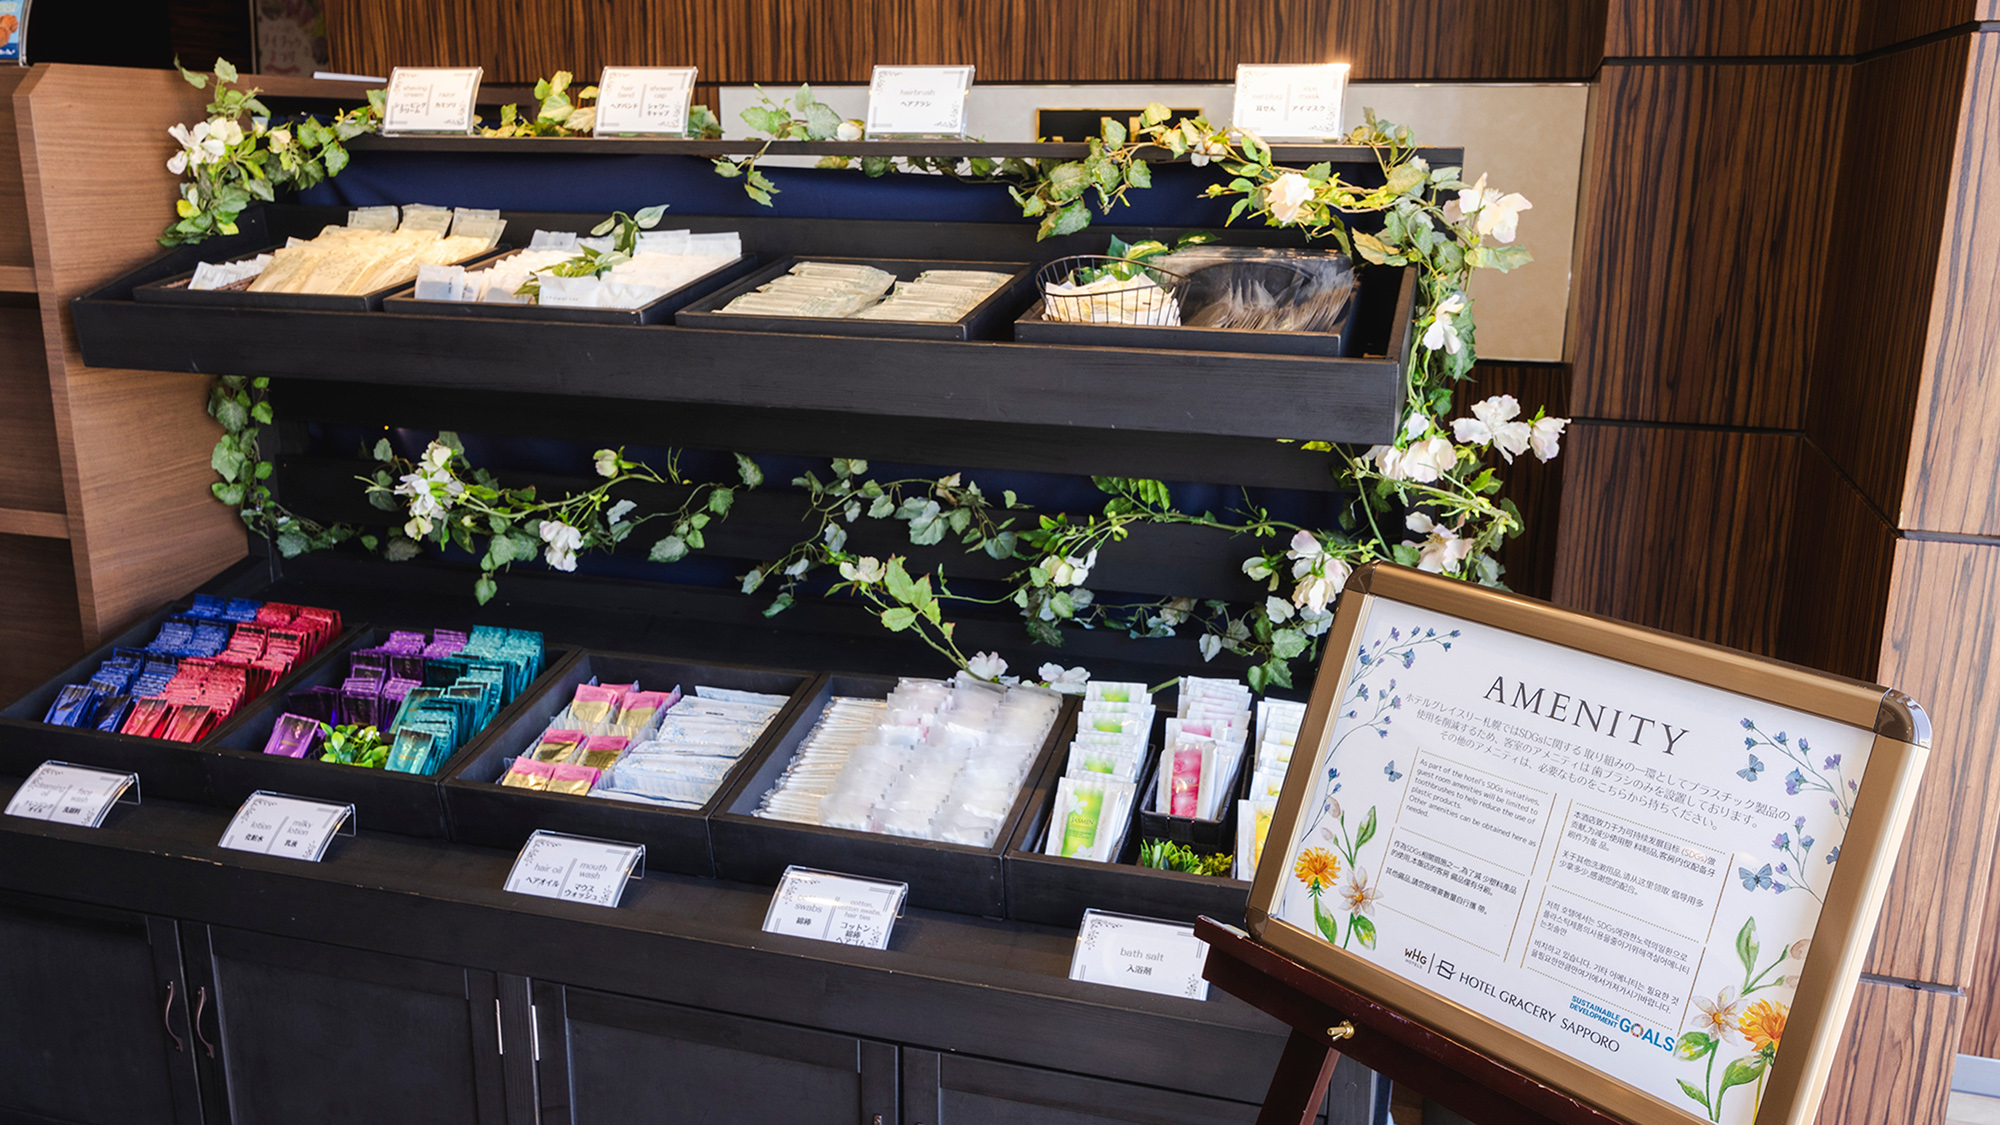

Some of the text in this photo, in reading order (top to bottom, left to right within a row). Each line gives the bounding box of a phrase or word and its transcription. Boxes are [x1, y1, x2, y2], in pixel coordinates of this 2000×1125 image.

[1483, 676, 1689, 756] AMENITY
[1419, 758, 1428, 767] As
[1428, 762, 1442, 772] part
[1451, 770, 1463, 779] the
[1463, 773, 1485, 787] hotel's
[1486, 781, 1503, 793] SDGs
[1504, 789, 1540, 806] initiatives,
[1410, 786, 1461, 809] plastic products.
[1416, 768, 1538, 816] guest room amenities will be limited to
[1414, 777, 1455, 796] toothbrushes
[1456, 792, 1464, 800] to
[1464, 794, 1479, 805] help
[1478, 800, 1501, 813] reduce
[1502, 808, 1514, 817] the
[1514, 813, 1527, 822] use
[1405, 804, 1428, 818] needed.
[292, 820, 312, 828] milky
[1408, 794, 1427, 806] Other
[1428, 803, 1458, 818] amenities
[1459, 814, 1471, 823] can
[1471, 818, 1481, 826] be
[1481, 822, 1511, 838] obtained
[1511, 832, 1527, 844] here
[250, 821, 272, 830] lotion
[287, 826, 308, 836] lotion
[534, 863, 564, 874] hair oil
[580, 862, 608, 872] mouth
[579, 871, 601, 880] wash
[526, 876, 560, 888] ヘアオイル
[574, 884, 596, 892] マウス
[564, 890, 598, 901] ウォッシュ
[795, 903, 822, 913] swabs
[850, 900, 874, 908] cotton,
[840, 922, 871, 932] コットン
[1120, 947, 1164, 962] bath salt
[1126, 964, 1153, 976] 入浴剤
[1459, 972, 1620, 1052] HOTEL GRACERY SAPPORO
[1571, 995, 1620, 1022] SUSTAINABLE
[1569, 1002, 1618, 1028] DEVELOPMENT
[1619, 1017, 1675, 1052] GOALS
